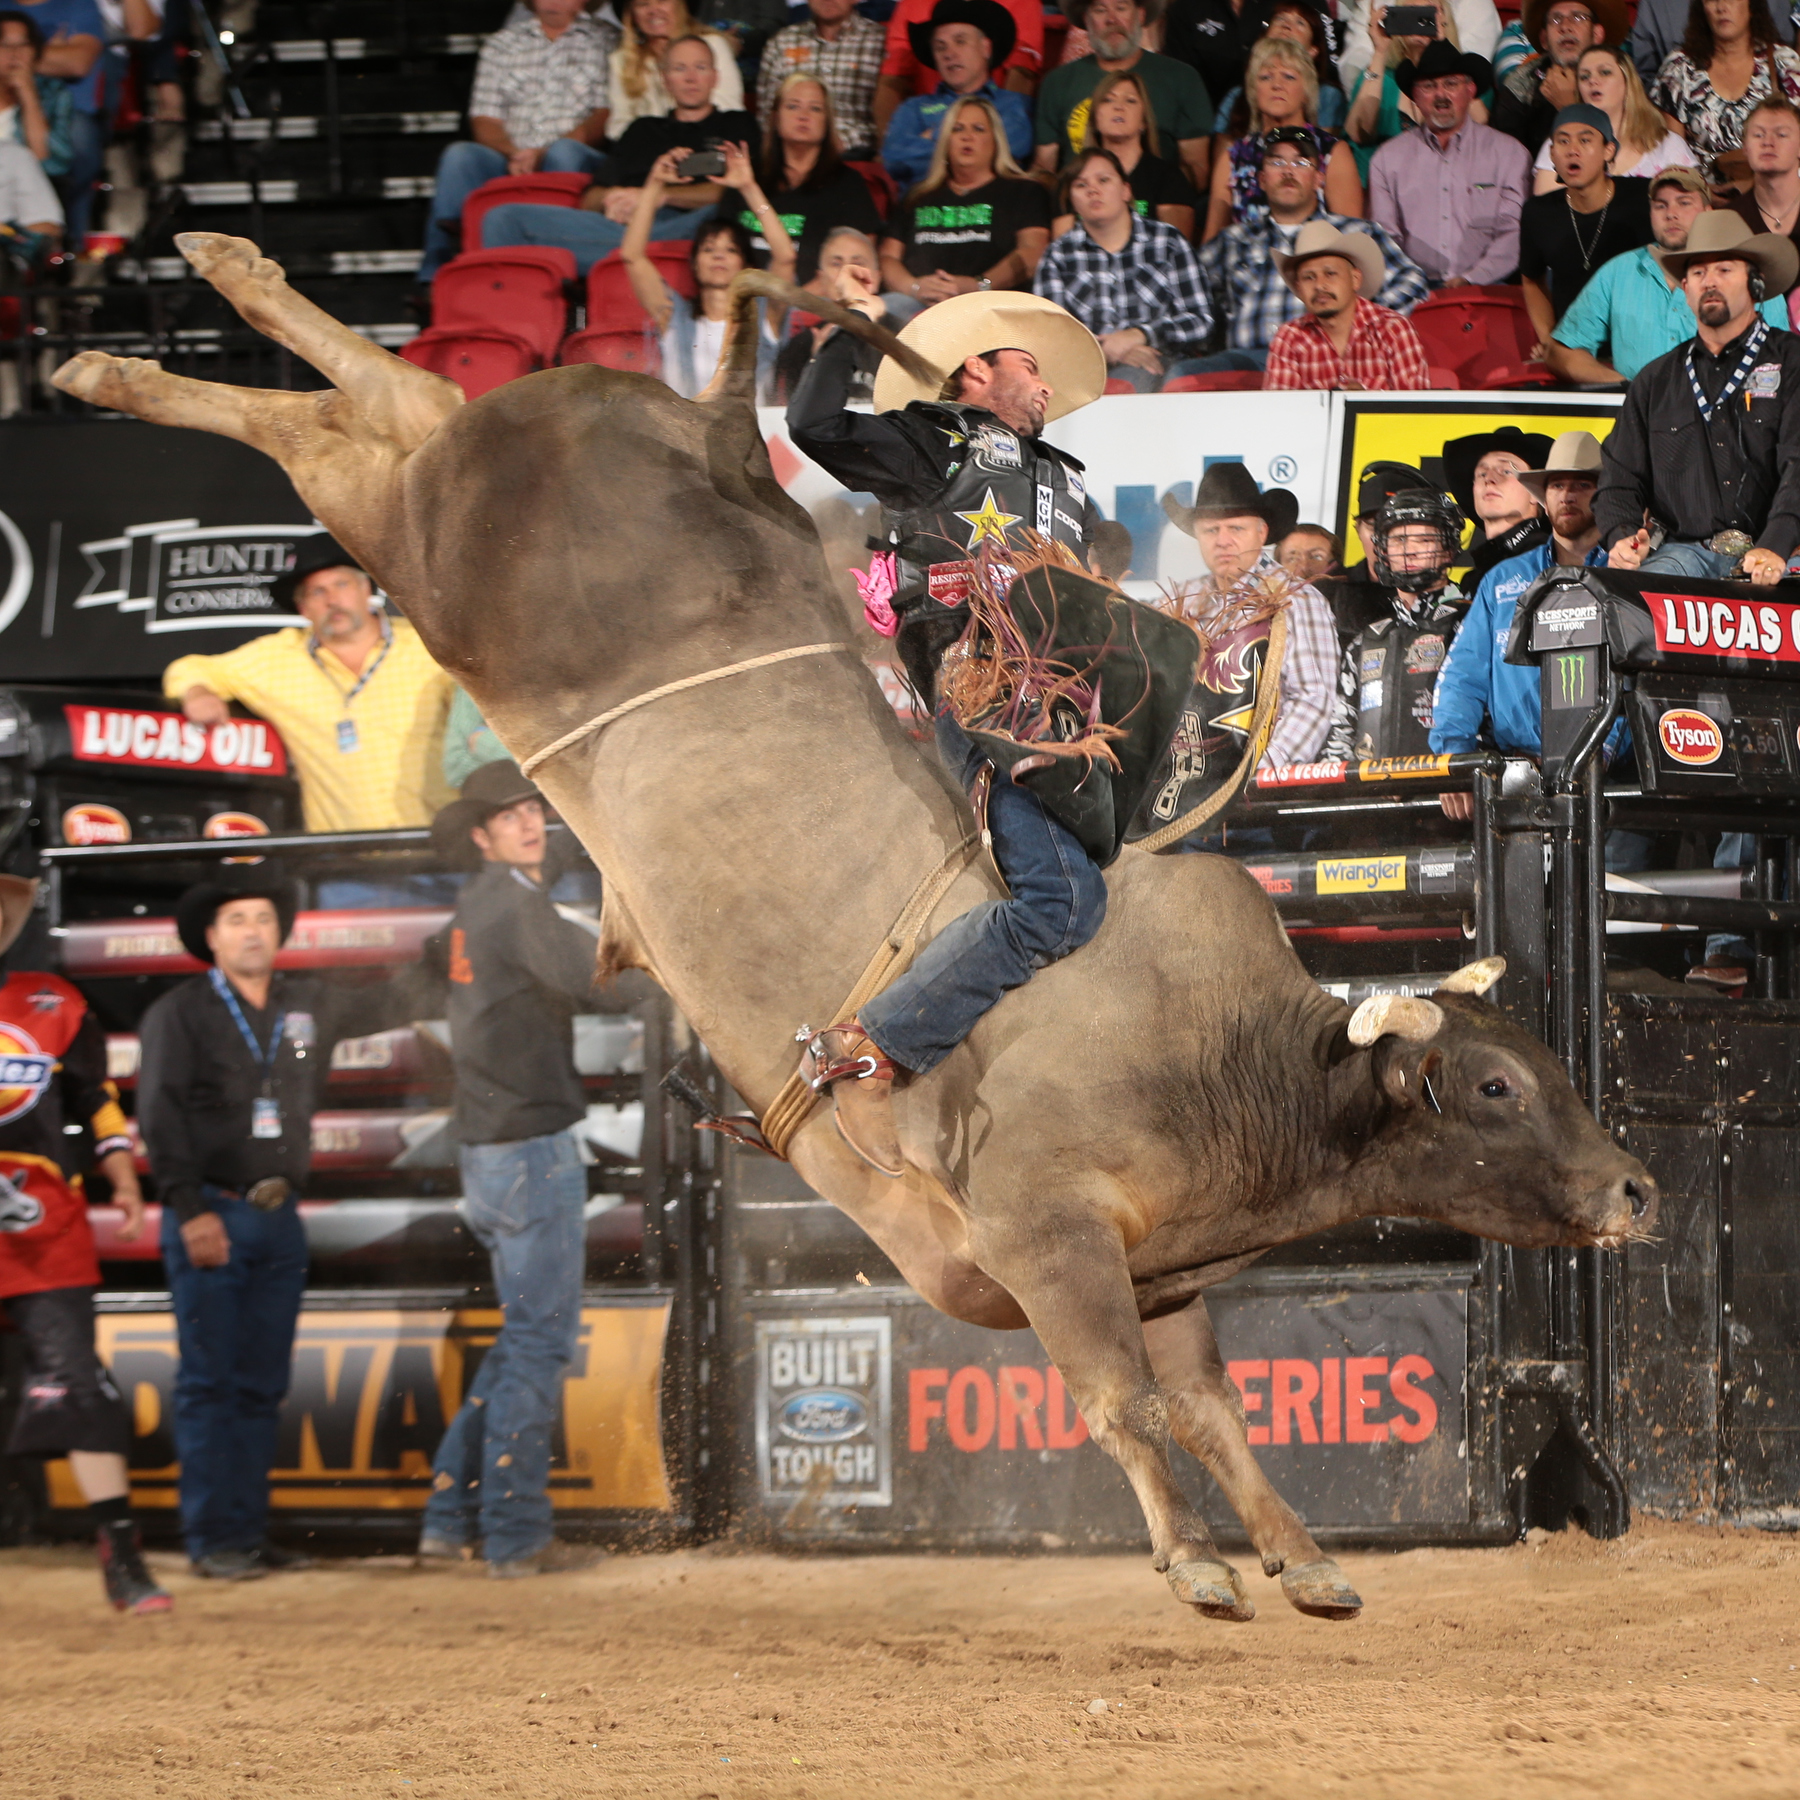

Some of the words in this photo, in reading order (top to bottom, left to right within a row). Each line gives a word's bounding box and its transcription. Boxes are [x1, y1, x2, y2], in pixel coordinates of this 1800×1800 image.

[1036, 489, 1052, 529] MGM
[1549, 621, 1585, 632] NETWORK
[1663, 598, 1783, 654] LUCAS
[82, 710, 207, 764] LUCAS
[211, 722, 274, 769] OIL
[1664, 720, 1717, 752] Tyson
[1262, 766, 1289, 783] LAS
[1294, 762, 1341, 780] VEGAS
[1368, 754, 1440, 774] DEWALT
[1322, 860, 1401, 888] Wrangler
[771, 1338, 877, 1387] BUILT
[794, 1400, 850, 1430] Ford
[909, 1364, 1093, 1453] FORD
[1226, 1353, 1438, 1445] ERIES
